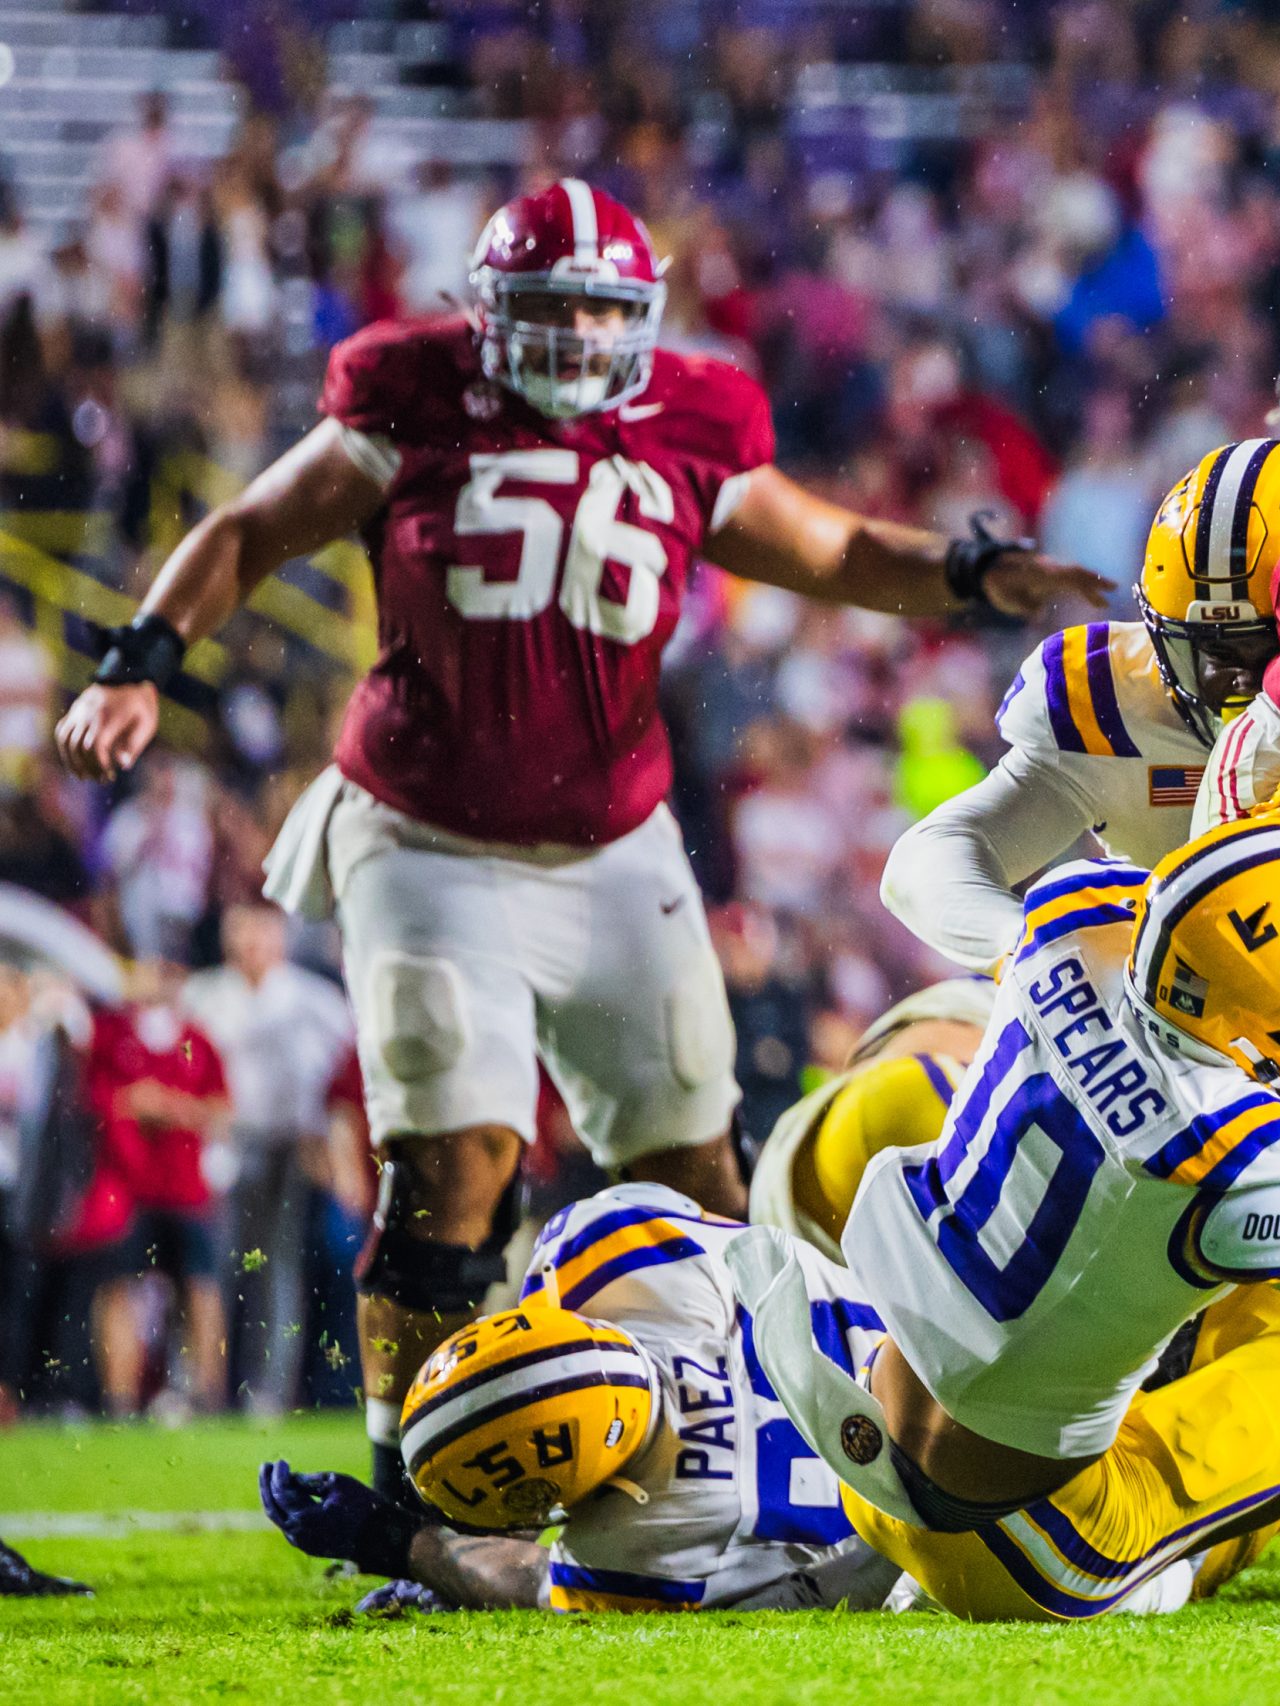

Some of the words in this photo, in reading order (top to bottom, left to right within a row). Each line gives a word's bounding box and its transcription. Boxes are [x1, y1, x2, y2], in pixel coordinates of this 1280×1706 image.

[446, 449, 675, 645] 56
[1201, 606, 1240, 621] LSU
[1029, 958, 1167, 1137] SPEARS
[903, 1017, 1106, 1323] 10
[672, 1354, 734, 1480] PAEZ
